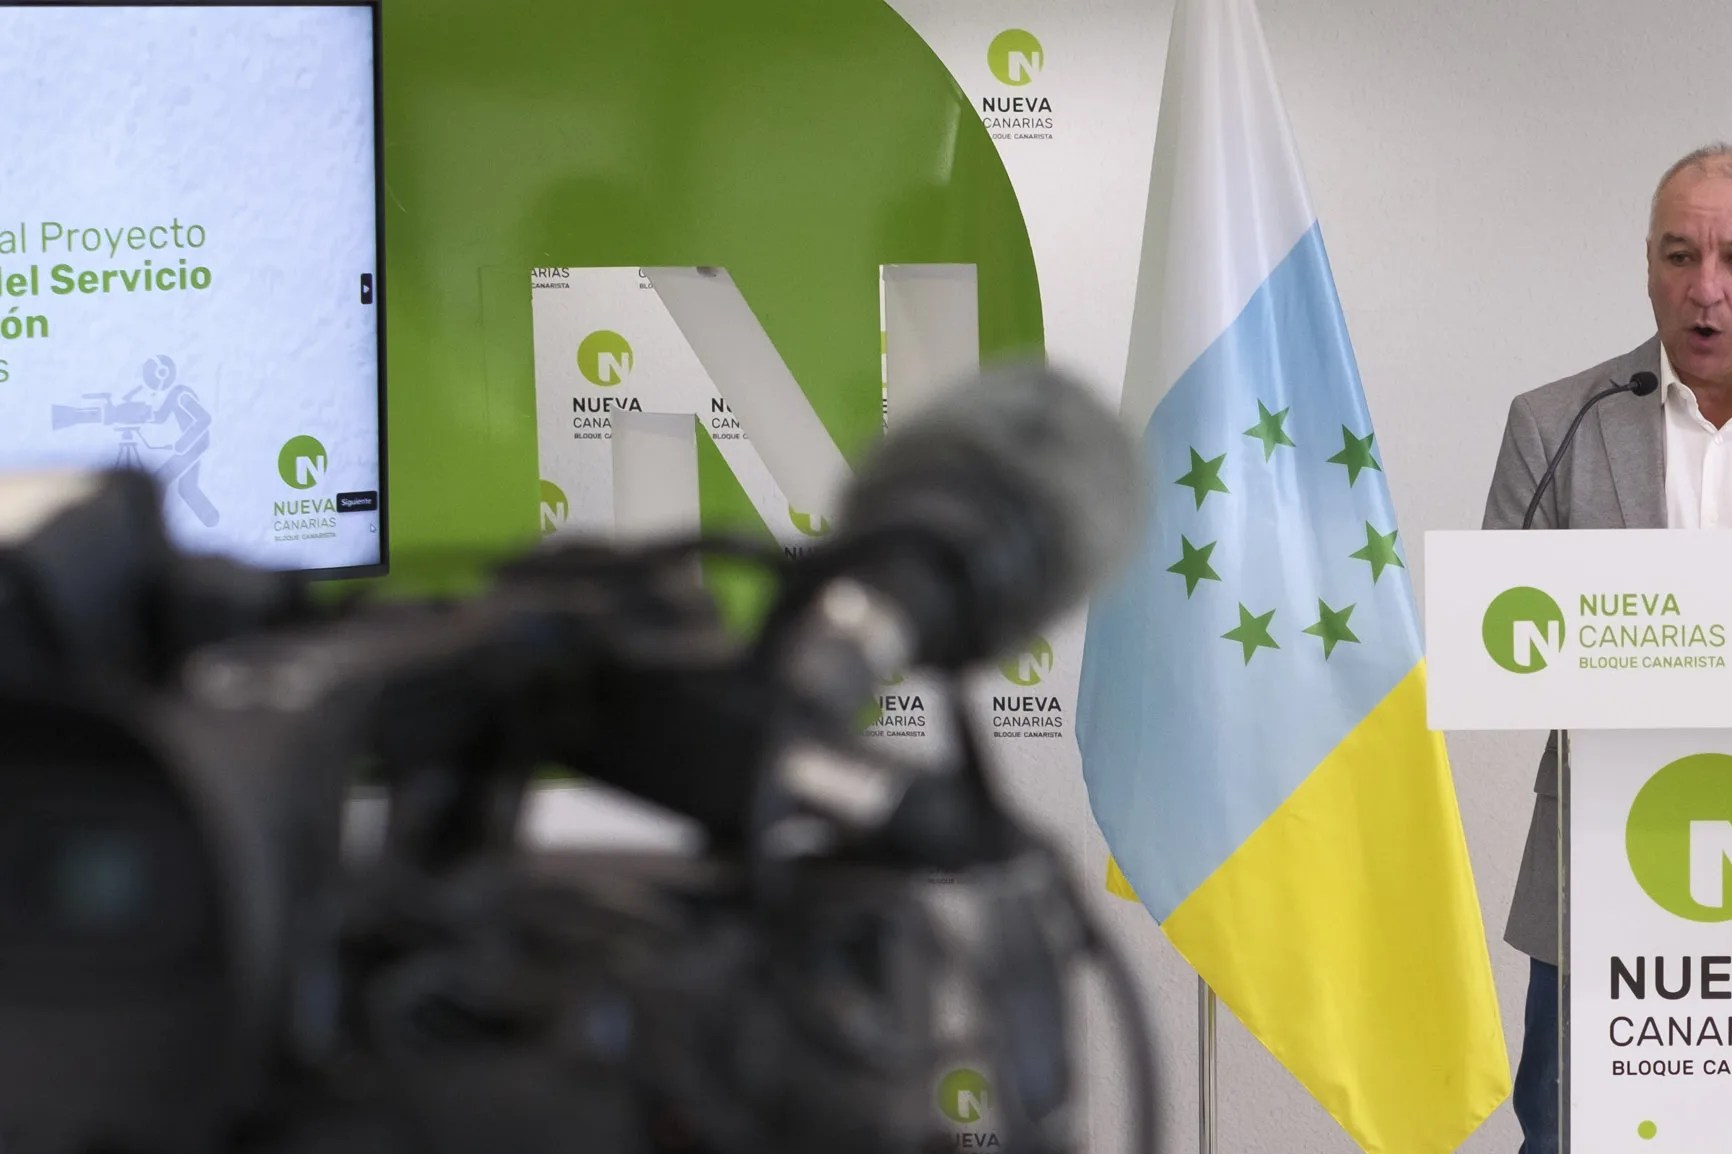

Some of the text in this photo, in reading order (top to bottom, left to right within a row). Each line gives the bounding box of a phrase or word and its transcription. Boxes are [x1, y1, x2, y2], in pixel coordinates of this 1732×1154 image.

[983, 97, 1052, 113] NUEVA
[983, 117, 1053, 129] CANARIAS
[41, 218, 206, 259] Proyecto
[51, 258, 212, 295] Servicio
[573, 397, 642, 413] NUEVA
[274, 498, 336, 516] NUEVA
[341, 498, 372, 508] Siguiente
[274, 517, 336, 532] CANARIAS
[1579, 593, 1681, 617] NUEVA
[1579, 623, 1726, 649] CANARIAS
[1579, 655, 1726, 670] BLOQUE CANARISTA
[993, 696, 1062, 712] NUEVA
[873, 715, 926, 727] NARIAS
[993, 716, 1063, 728] CANARIAS
[1612, 1059, 1694, 1077] BLOQUE
